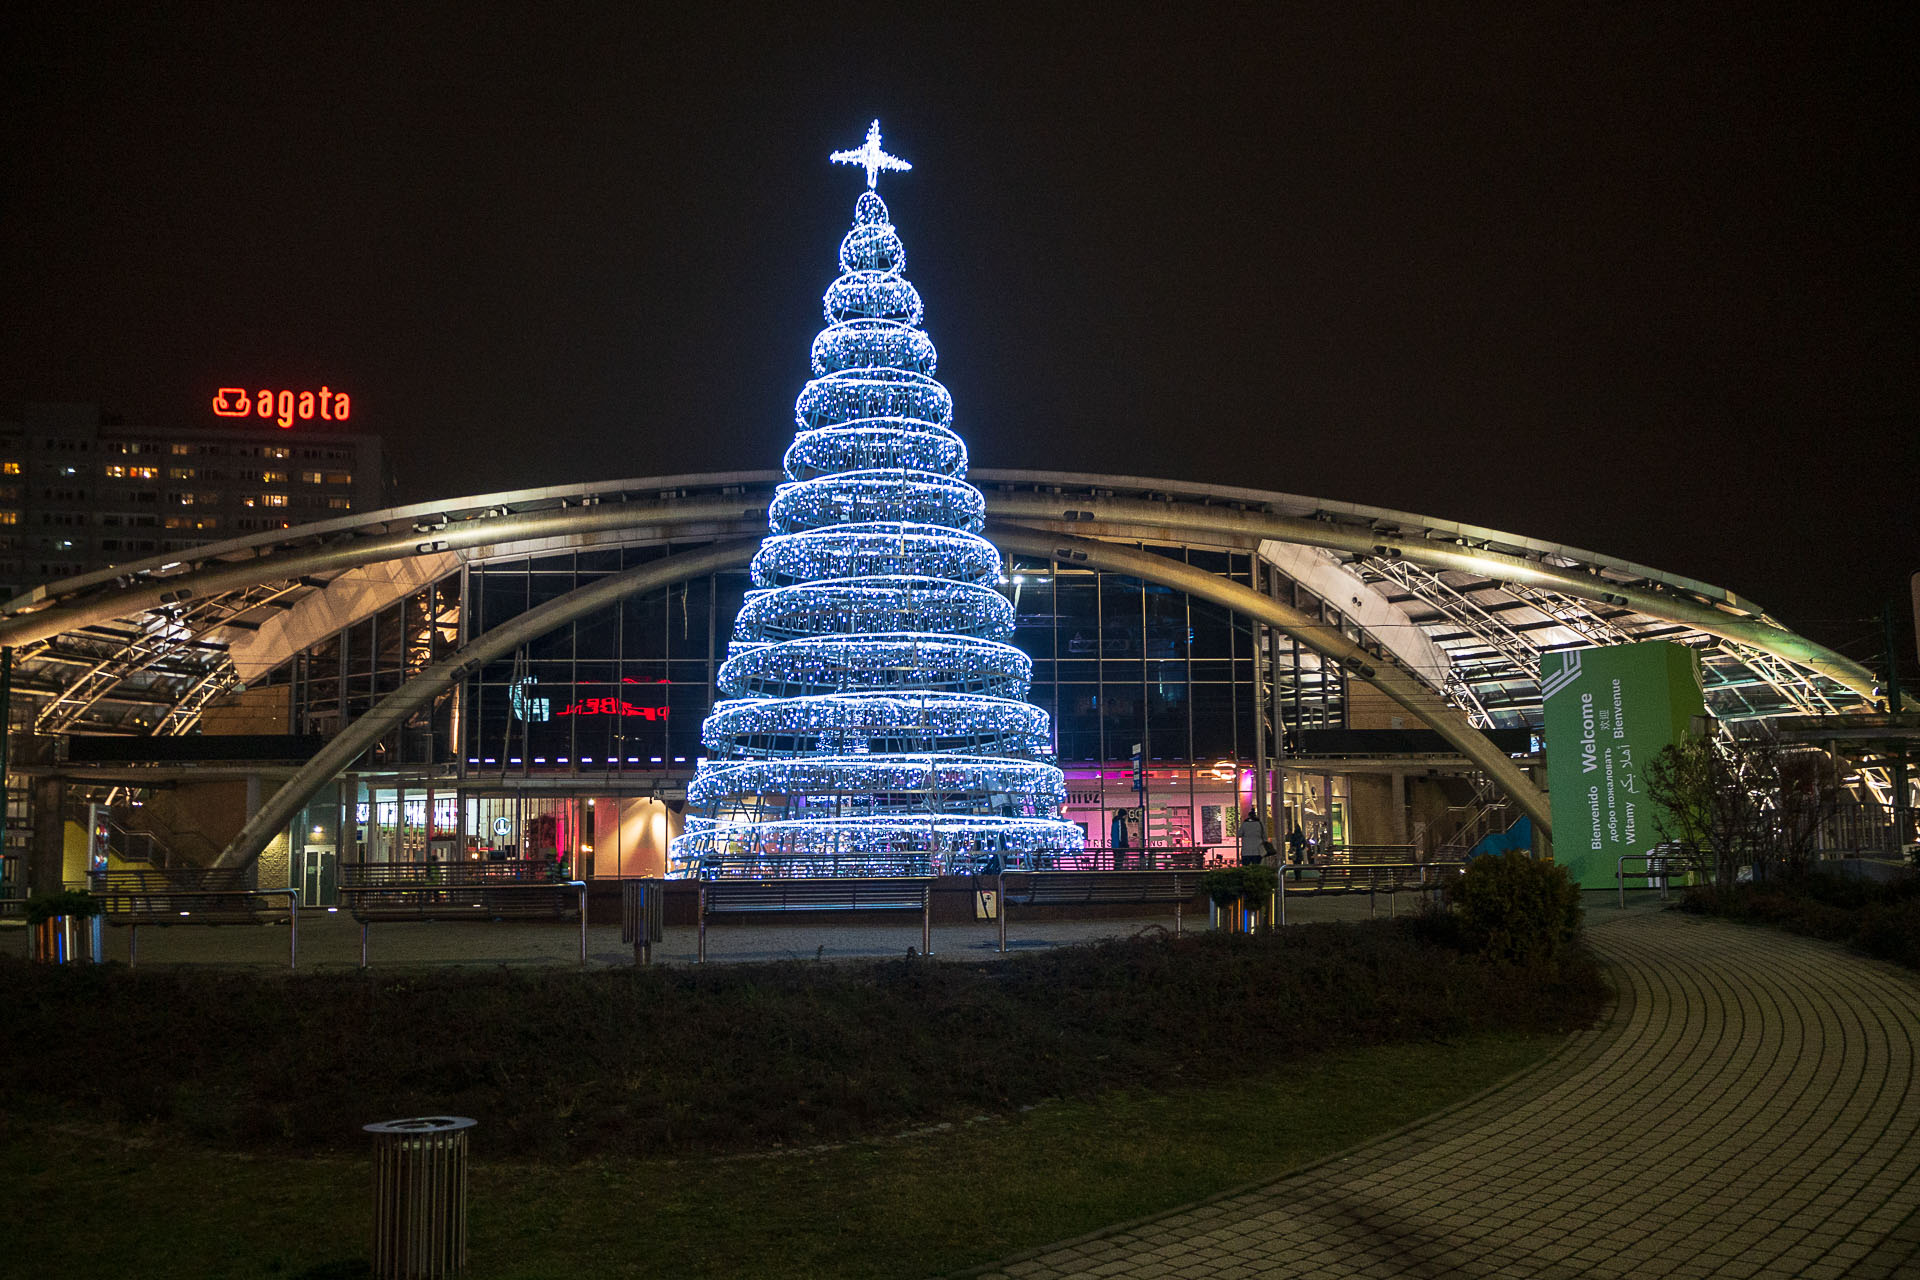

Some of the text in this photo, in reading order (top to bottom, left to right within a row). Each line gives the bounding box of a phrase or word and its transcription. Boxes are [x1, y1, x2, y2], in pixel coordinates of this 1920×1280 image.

[257, 386, 350, 428] agata
[1581, 693, 1596, 774] Welcome
[1599, 709, 1610, 731] 欢迎
[1613, 679, 1624, 739] Bienvenue
[1588, 785, 1602, 850] Bienvenido
[1624, 801, 1636, 845] Witamy
